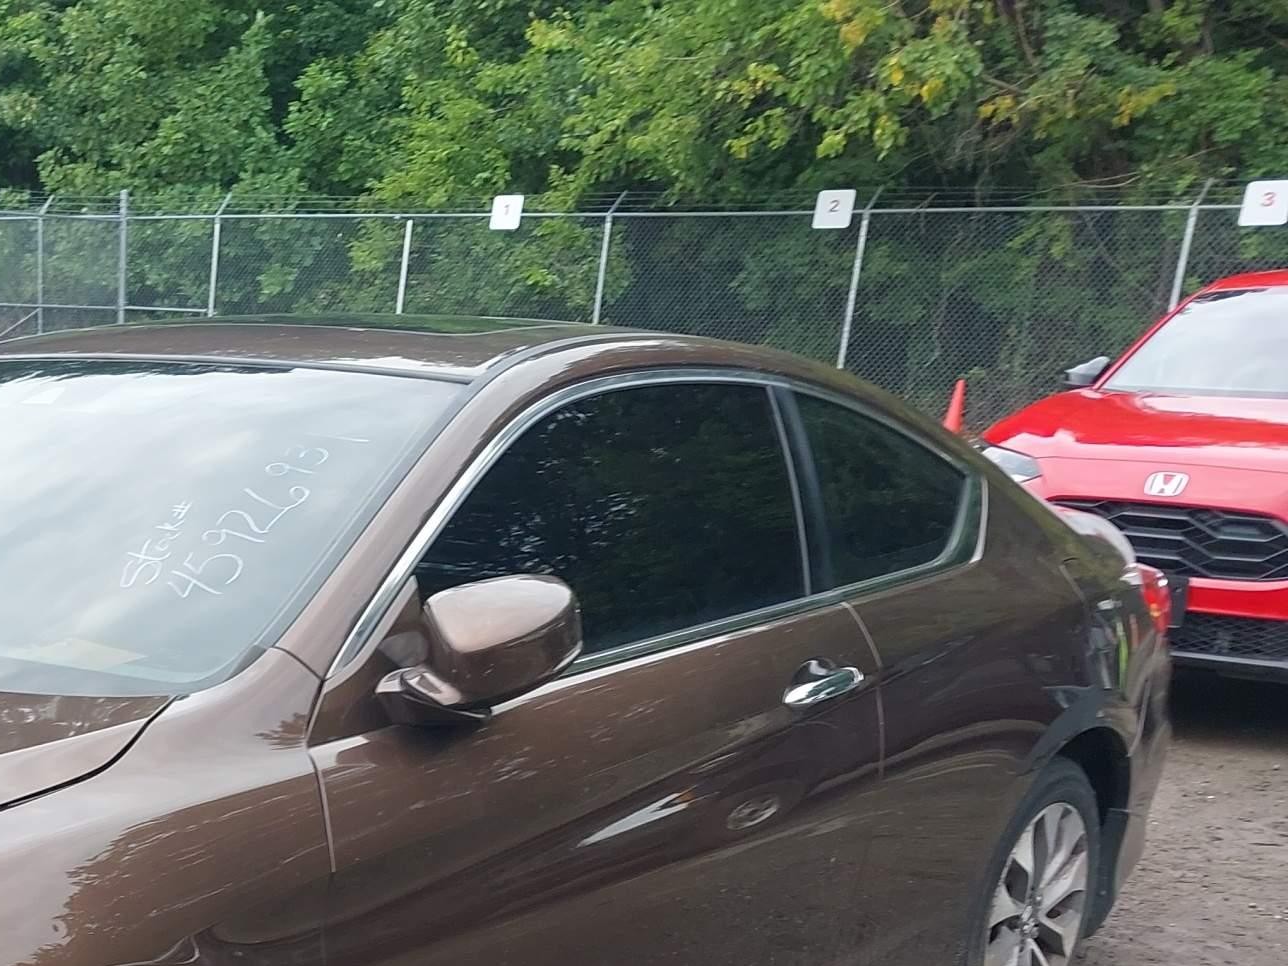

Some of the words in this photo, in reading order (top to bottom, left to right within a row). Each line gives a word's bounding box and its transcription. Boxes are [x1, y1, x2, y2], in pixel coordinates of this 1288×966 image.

[828, 199, 841, 213] 2
[1261, 191, 1277, 207] 3
[504, 203, 511, 216] 1
